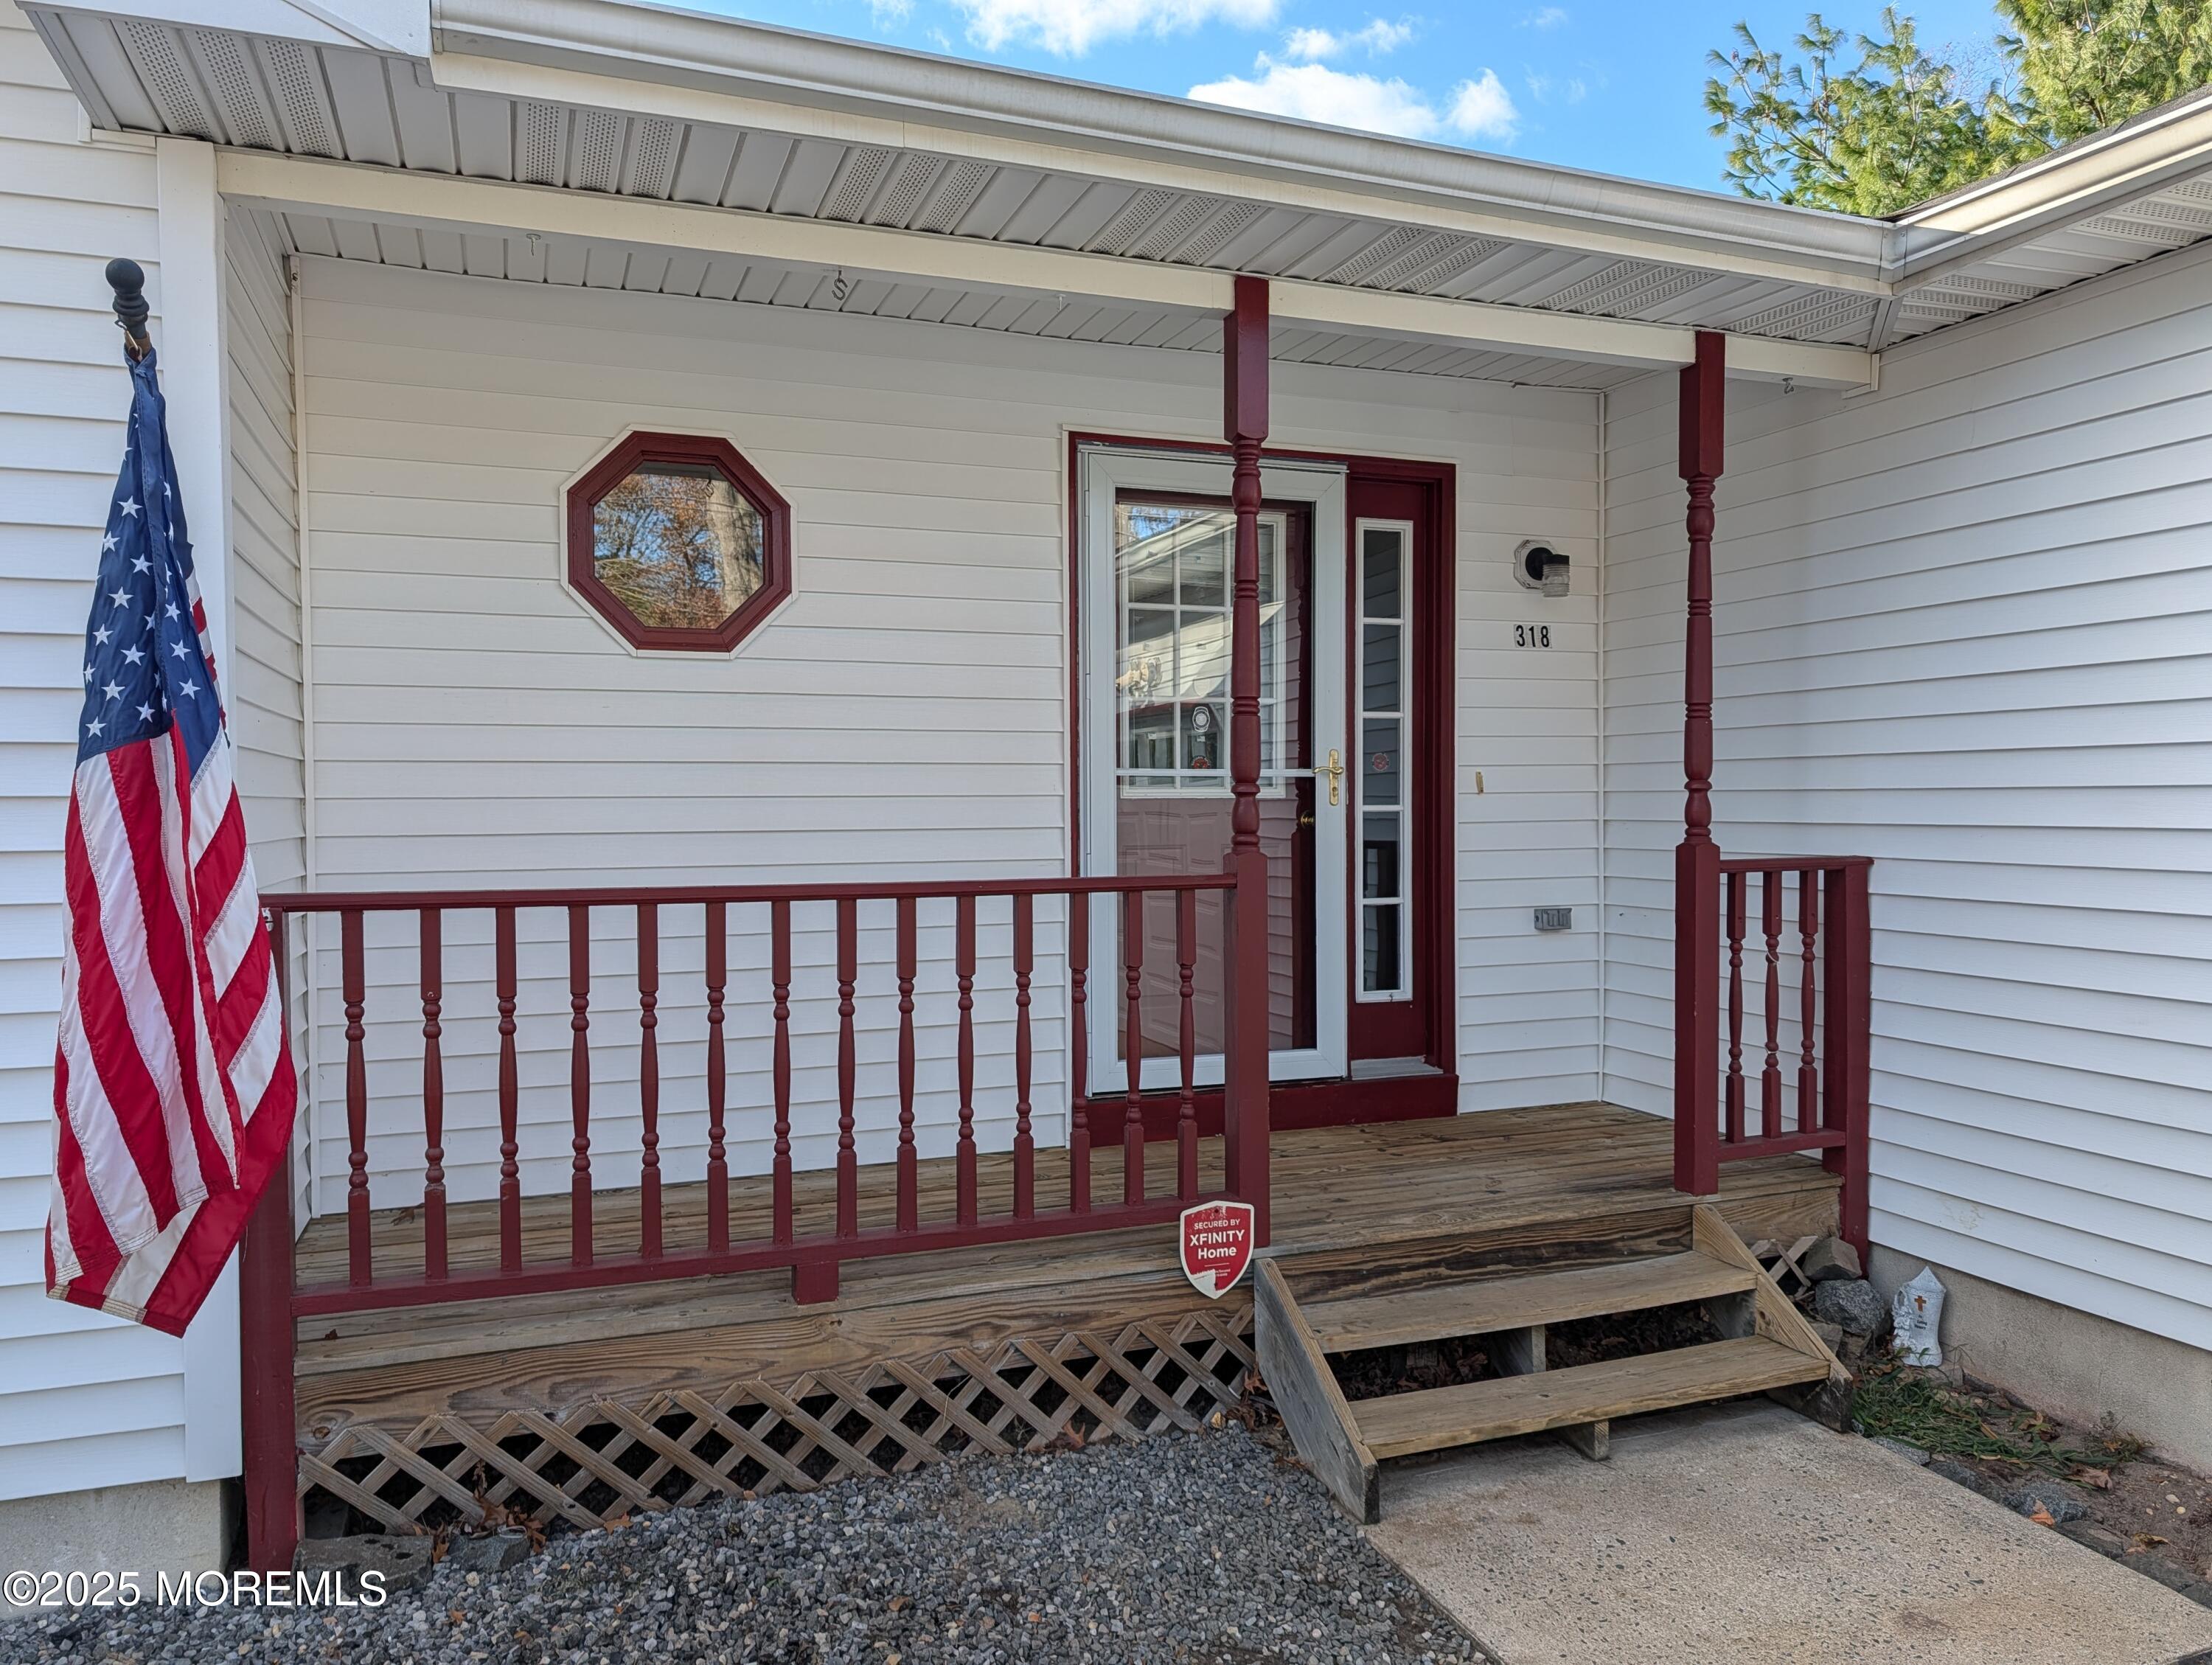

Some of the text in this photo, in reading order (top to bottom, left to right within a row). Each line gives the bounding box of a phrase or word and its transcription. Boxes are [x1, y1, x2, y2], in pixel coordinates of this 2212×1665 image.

[1515, 625, 1550, 647] 318
[1194, 1220, 1228, 1229] SECURED
[1190, 1230, 1245, 1246] XFINITY
[1198, 1247, 1237, 1259] Home
